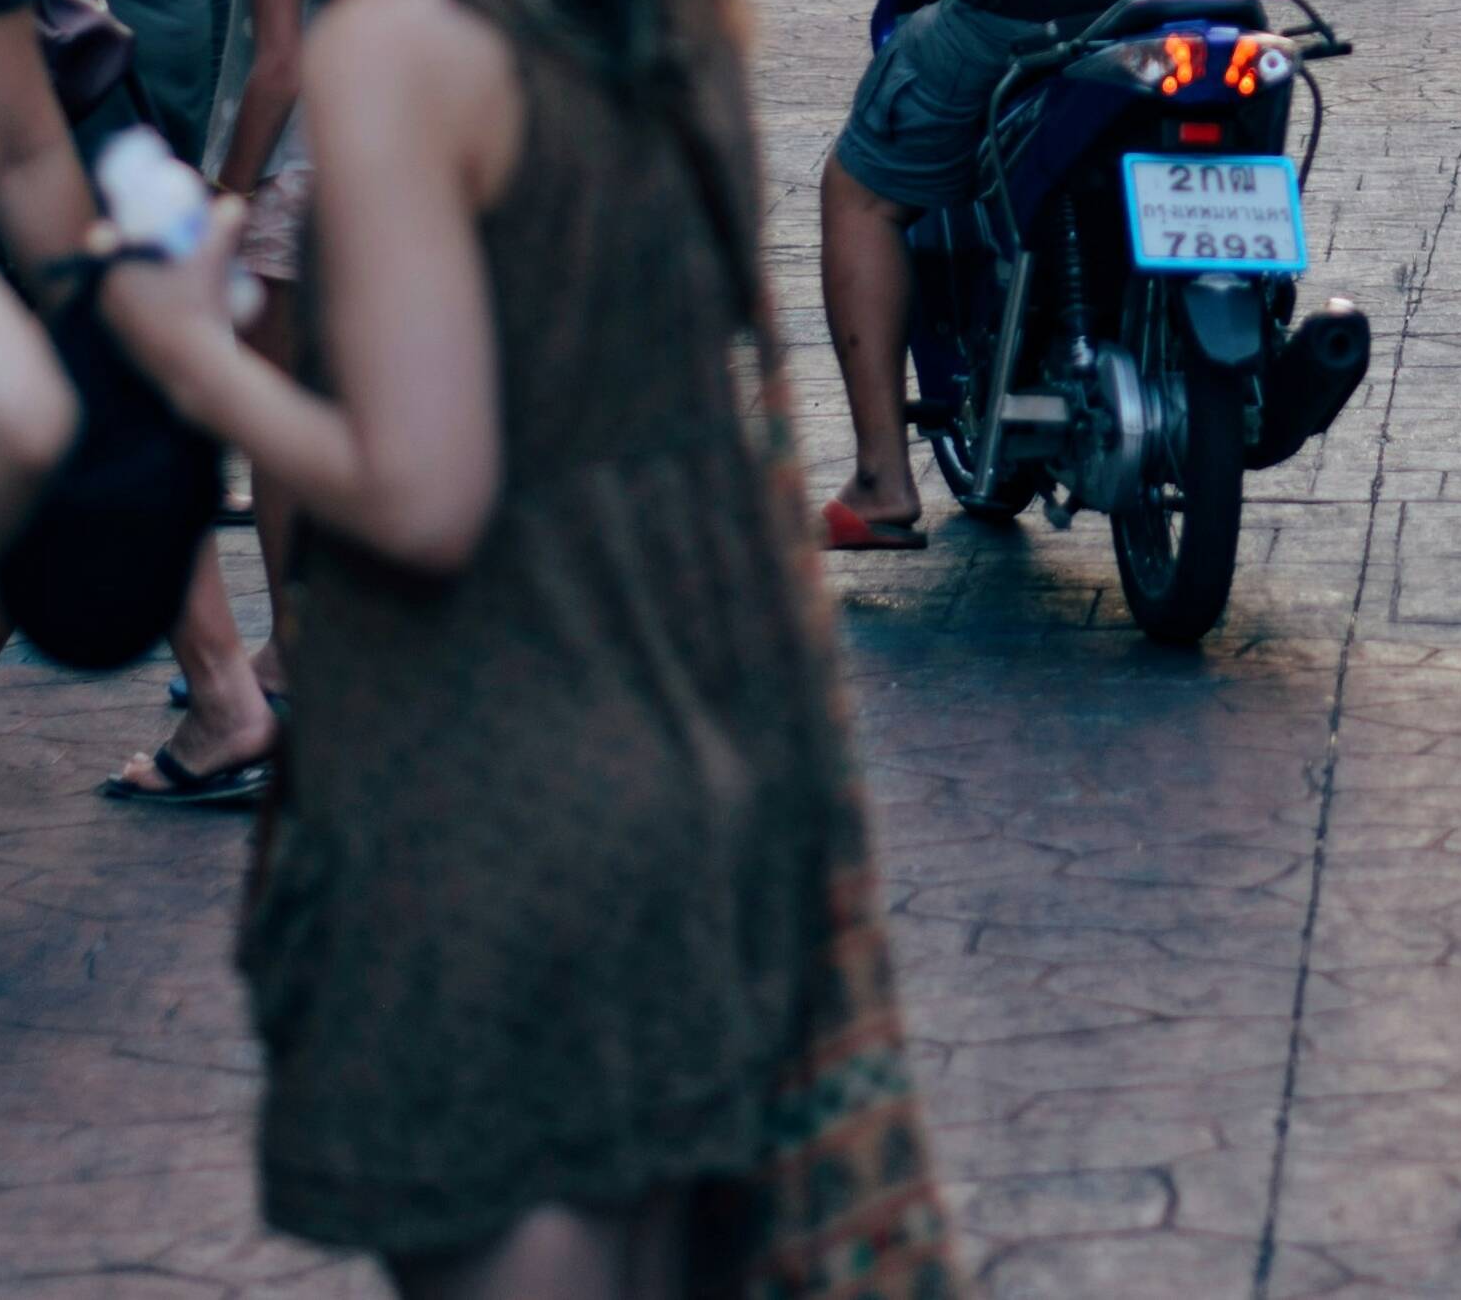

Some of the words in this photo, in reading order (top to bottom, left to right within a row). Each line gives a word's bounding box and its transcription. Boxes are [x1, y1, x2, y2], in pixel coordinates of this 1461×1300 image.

[1142, 202, 1292, 225] กรุงเทพมหานคร
[1162, 231, 1278, 260] 7893
